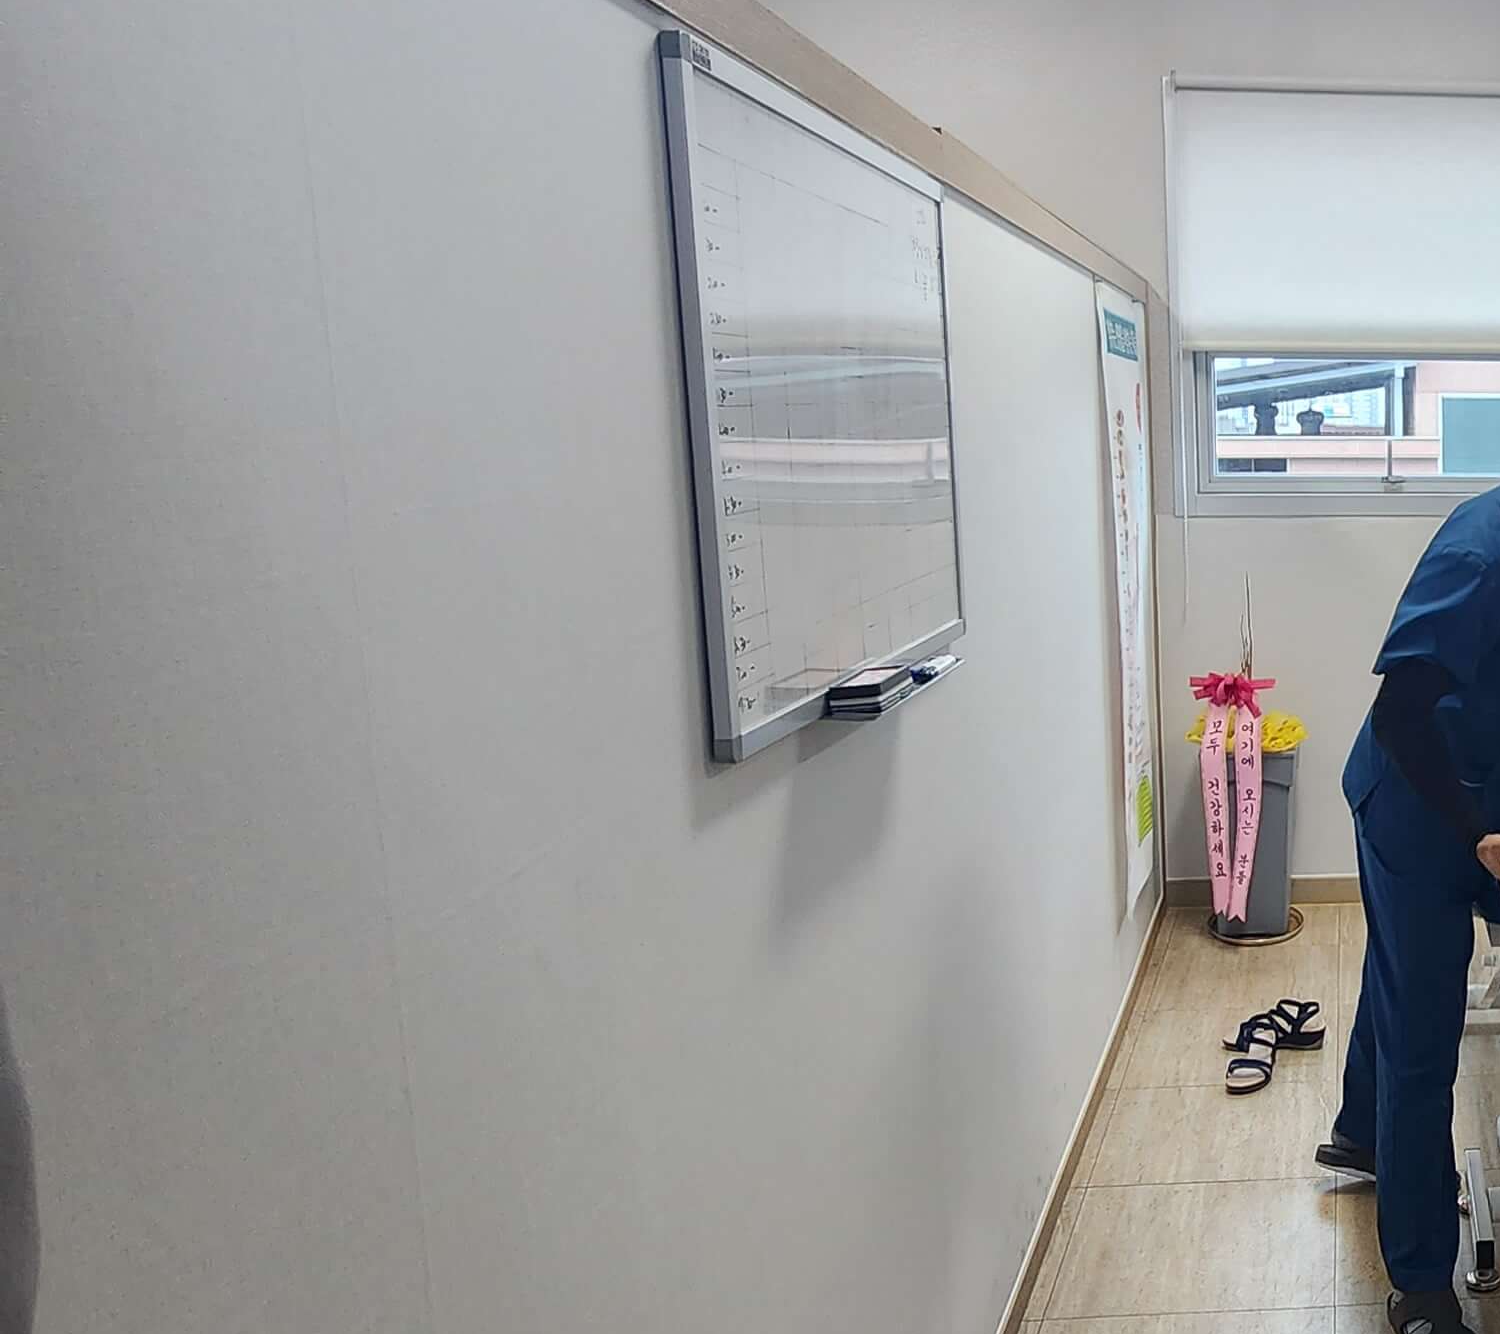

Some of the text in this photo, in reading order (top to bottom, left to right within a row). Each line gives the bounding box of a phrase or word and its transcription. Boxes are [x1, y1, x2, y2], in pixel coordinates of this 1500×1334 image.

[1206, 720, 1226, 877] 모두 건강하세요
[1237, 721, 1257, 885] 여기에 오시는 분들
